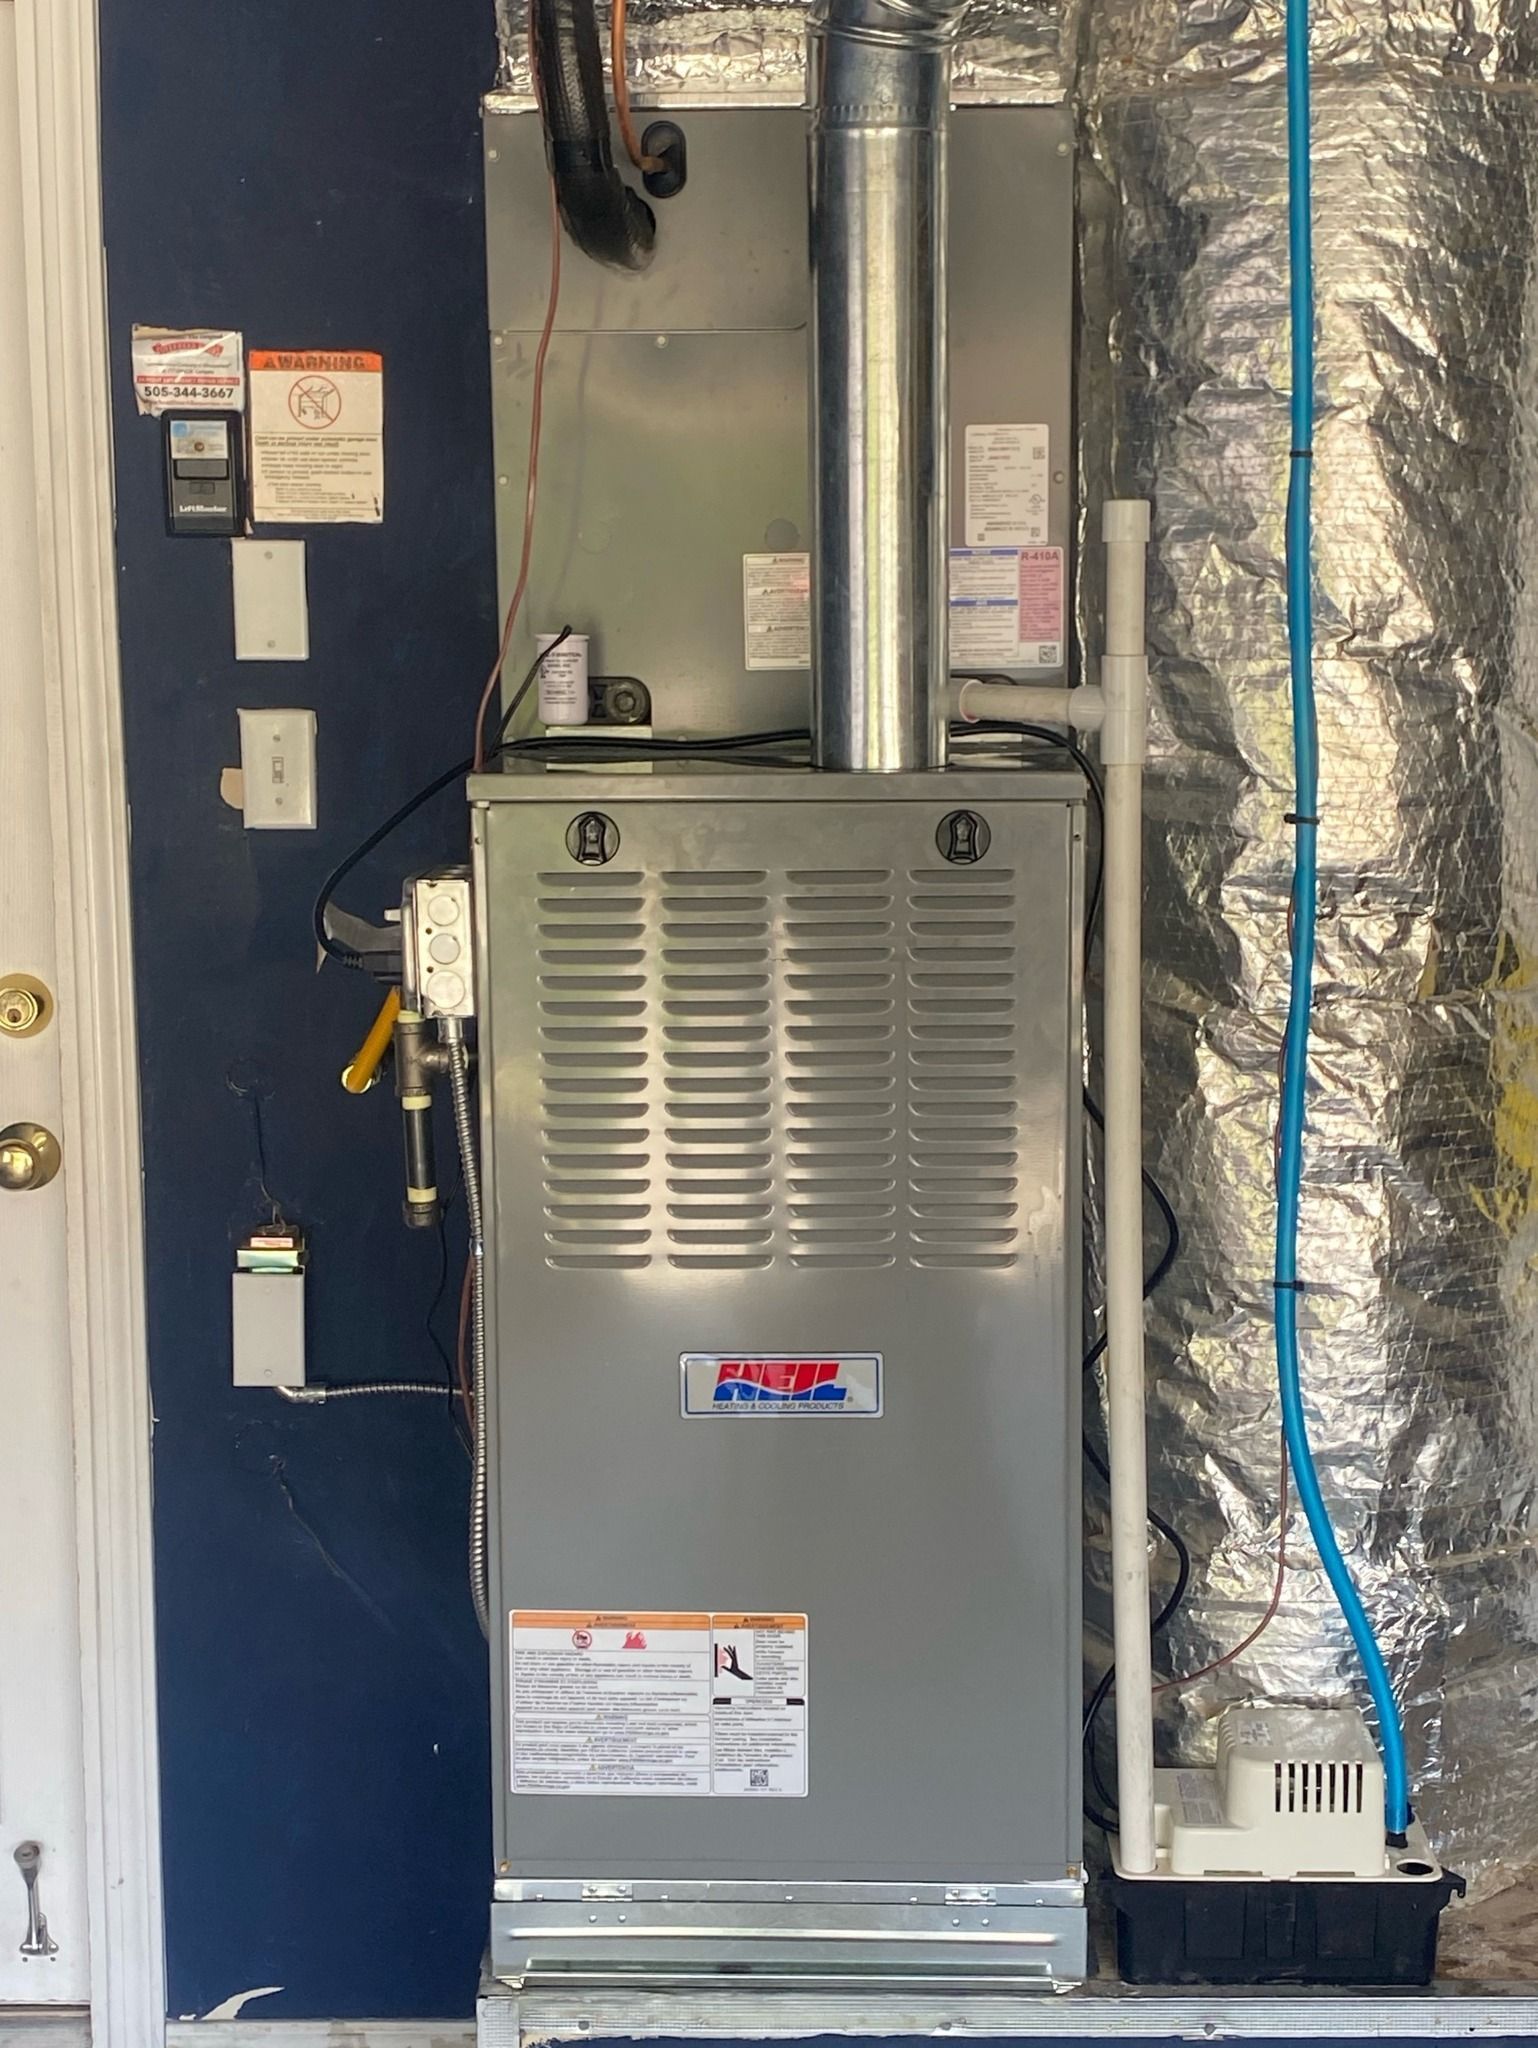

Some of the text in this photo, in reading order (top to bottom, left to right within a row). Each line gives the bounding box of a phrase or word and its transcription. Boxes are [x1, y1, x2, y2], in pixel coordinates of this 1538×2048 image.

[278, 355, 366, 370] WARNING
[144, 386, 235, 399] 505-344-3667
[1020, 551, 1060, 561] R-410A
[713, 1362, 848, 1402] HEIL
[711, 1402, 750, 1411] HEATING
[758, 1403, 797, 1411] COOLING
[798, 1402, 845, 1411] PRODUCTS
